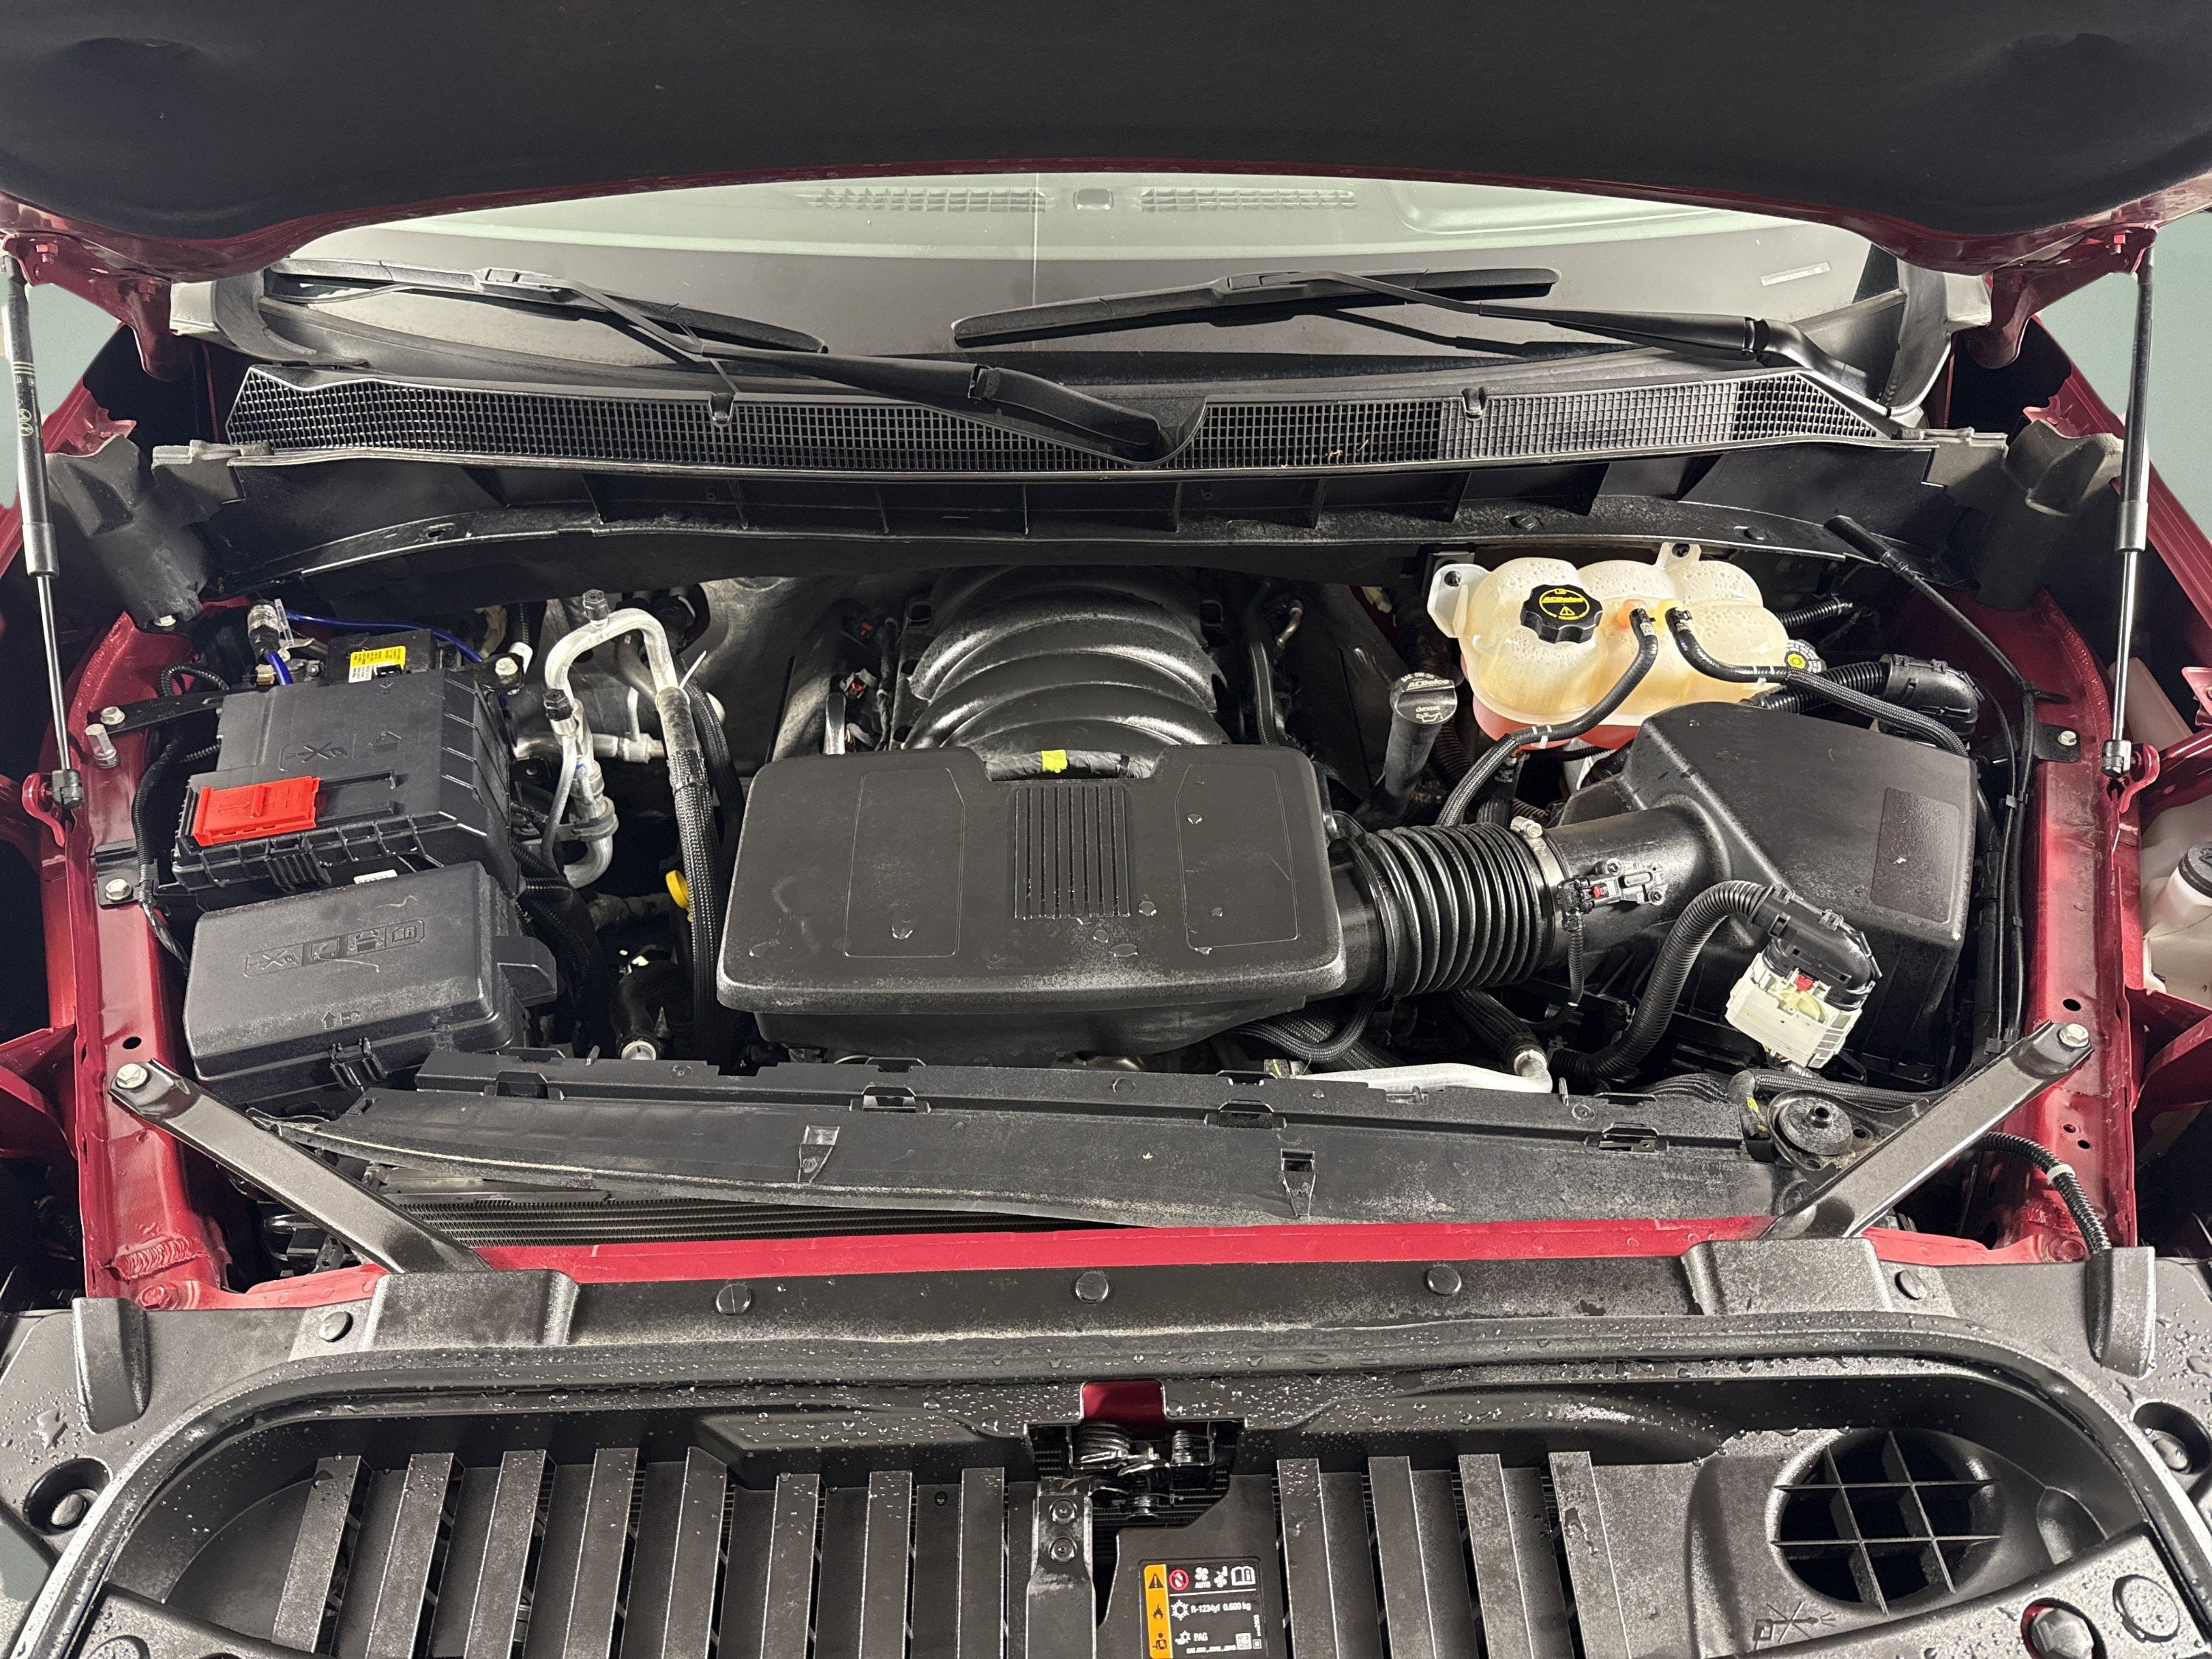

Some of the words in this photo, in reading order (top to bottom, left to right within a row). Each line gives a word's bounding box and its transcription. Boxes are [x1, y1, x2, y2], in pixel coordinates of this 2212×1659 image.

[1408, 678, 1450, 689] ACDelco
[1191, 1603, 1220, 1613] R-1234yf
[1242, 1601, 1251, 1611] kg
[1194, 1632, 1208, 1642] PAG
